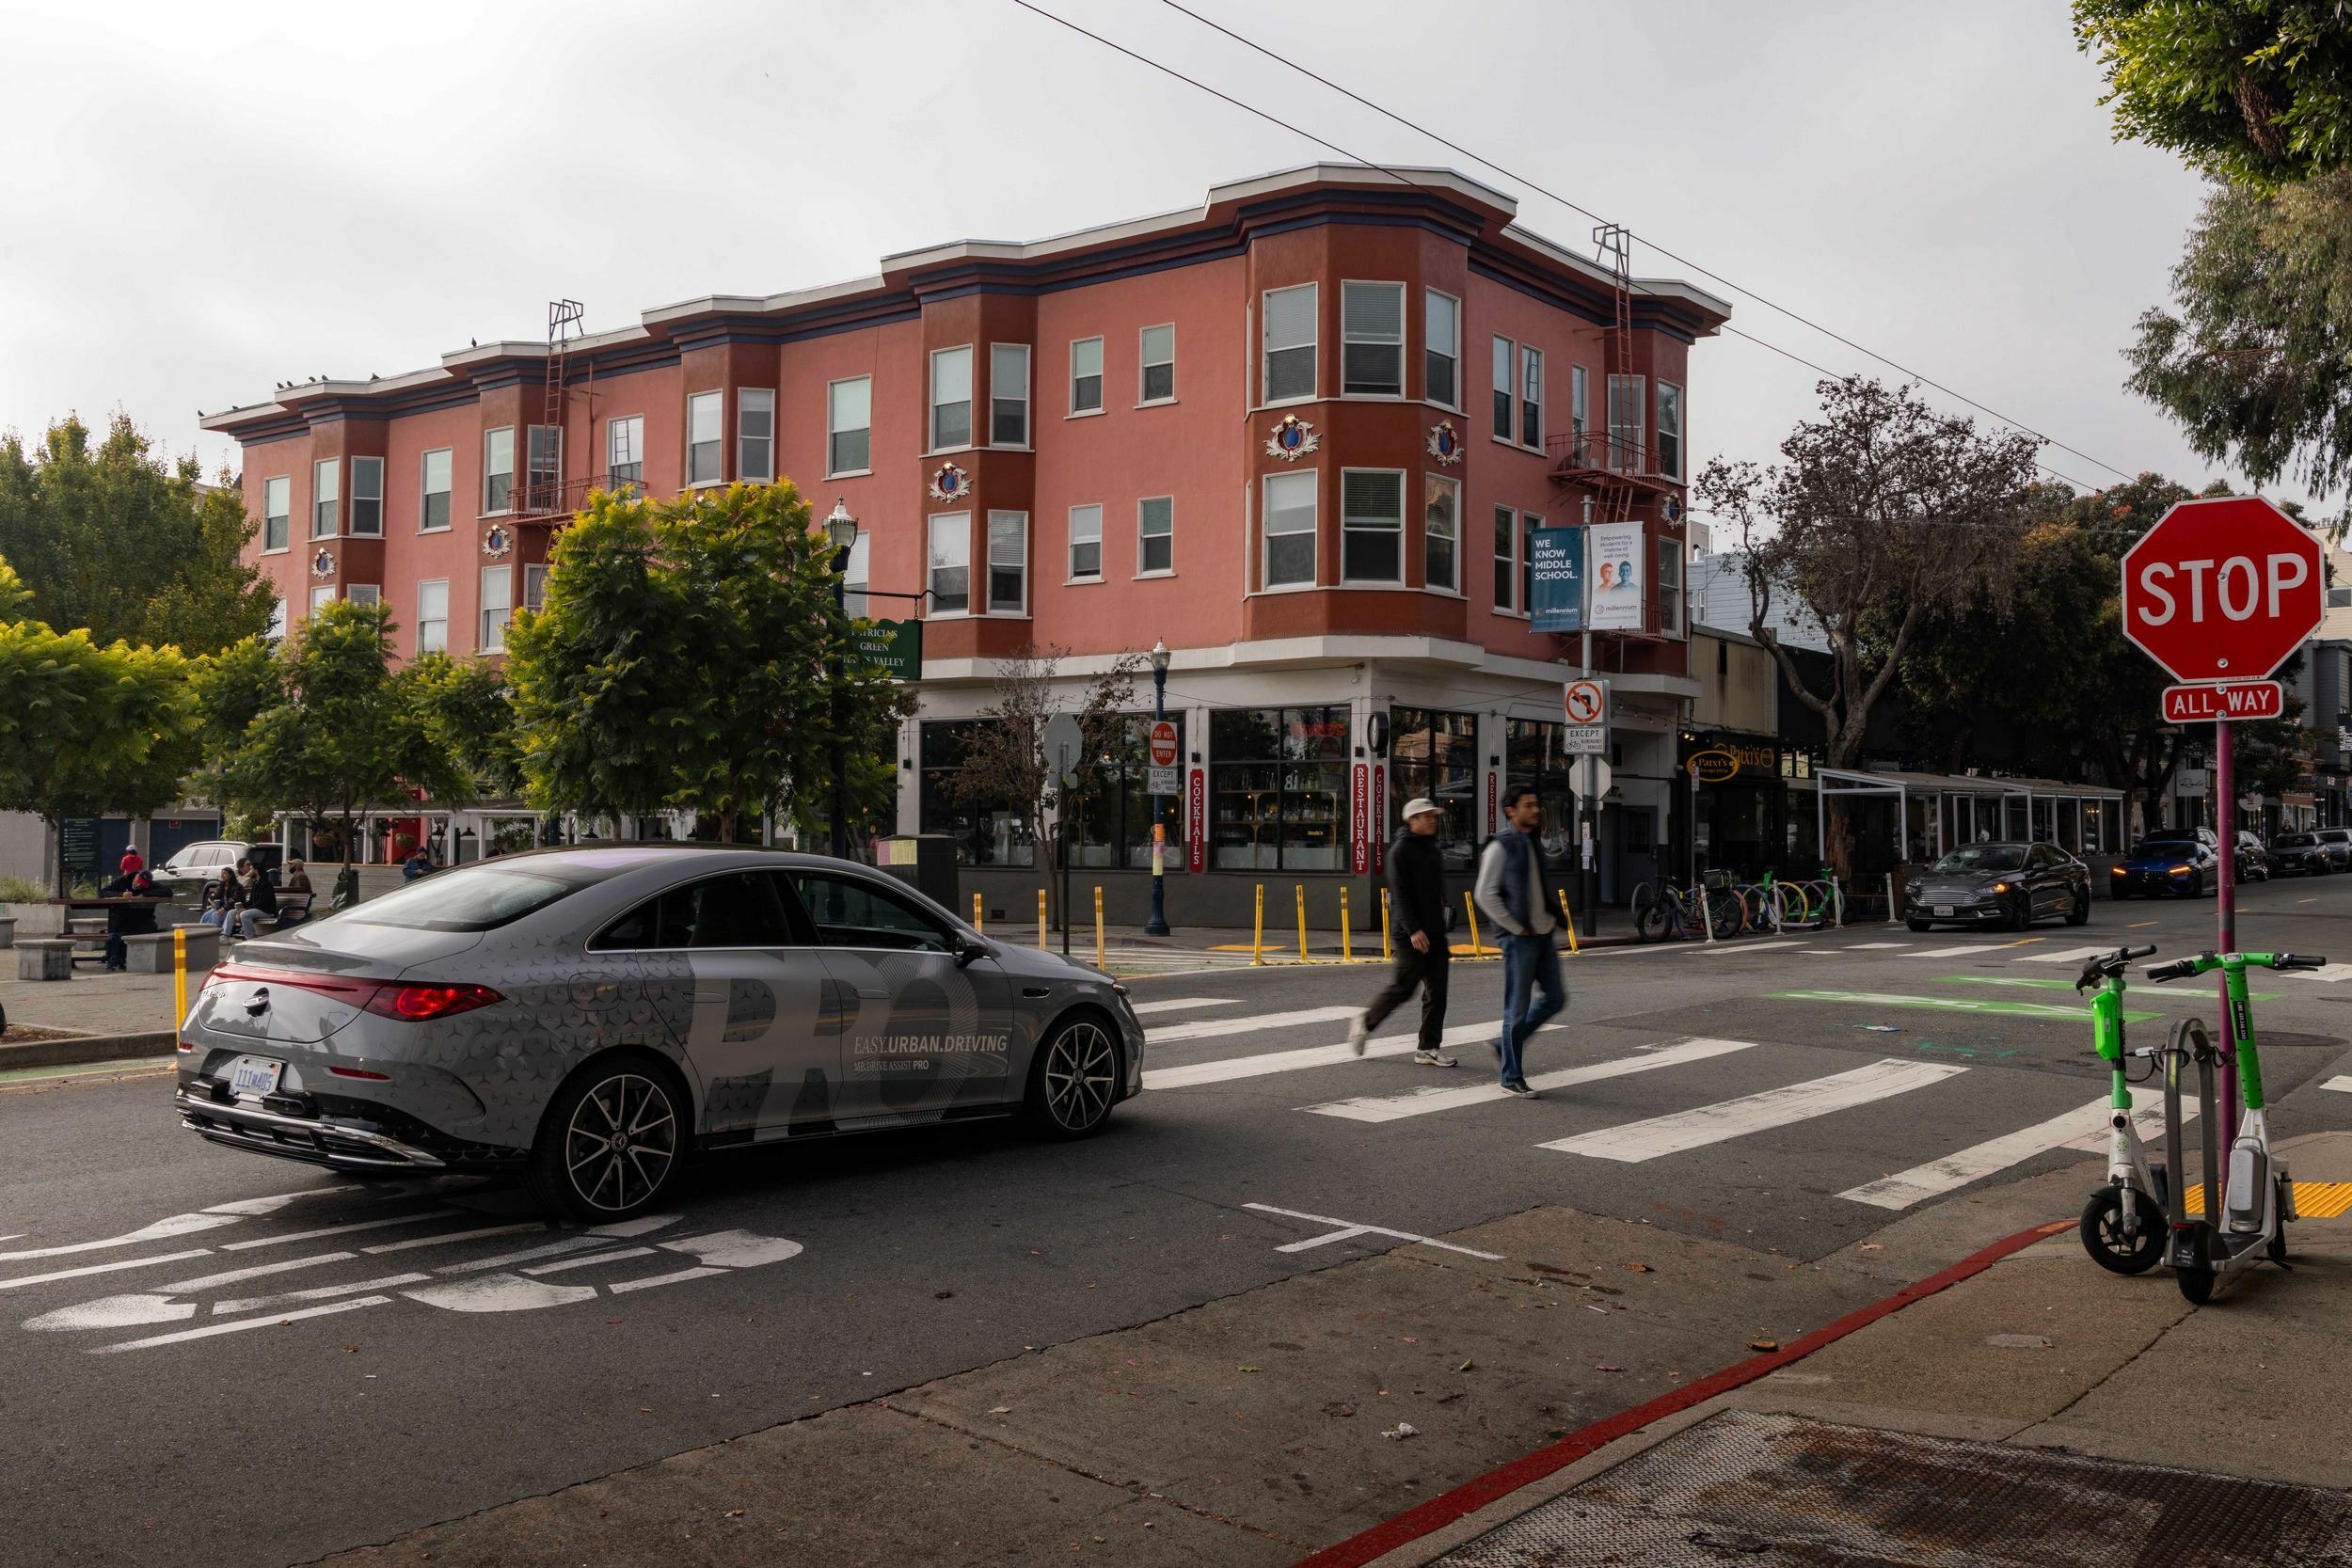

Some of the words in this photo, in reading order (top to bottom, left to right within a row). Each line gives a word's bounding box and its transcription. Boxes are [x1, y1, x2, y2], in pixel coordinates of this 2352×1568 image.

[1535, 539, 1550, 547] WE
[1535, 549, 1565, 559] KNOW
[1535, 560, 1572, 569] MIDDLE
[1535, 570, 1578, 580] SCHOOL.
[2137, 552, 2309, 626] STOP
[860, 642, 889, 652] GREEN
[873, 657, 905, 667] VALLEY
[2173, 693, 2215, 715] ALL
[2227, 689, 2271, 712] WAY
[1154, 730, 1162, 738] DO
[1152, 769, 1174, 779] EXCEPT
[1193, 777, 1201, 864] COCKTAILS
[853, 1035, 1008, 1054] EASY.URBAN.DRIVING
[888, 1061, 913, 1070] ASSIST
[913, 1060, 930, 1070] PRO
